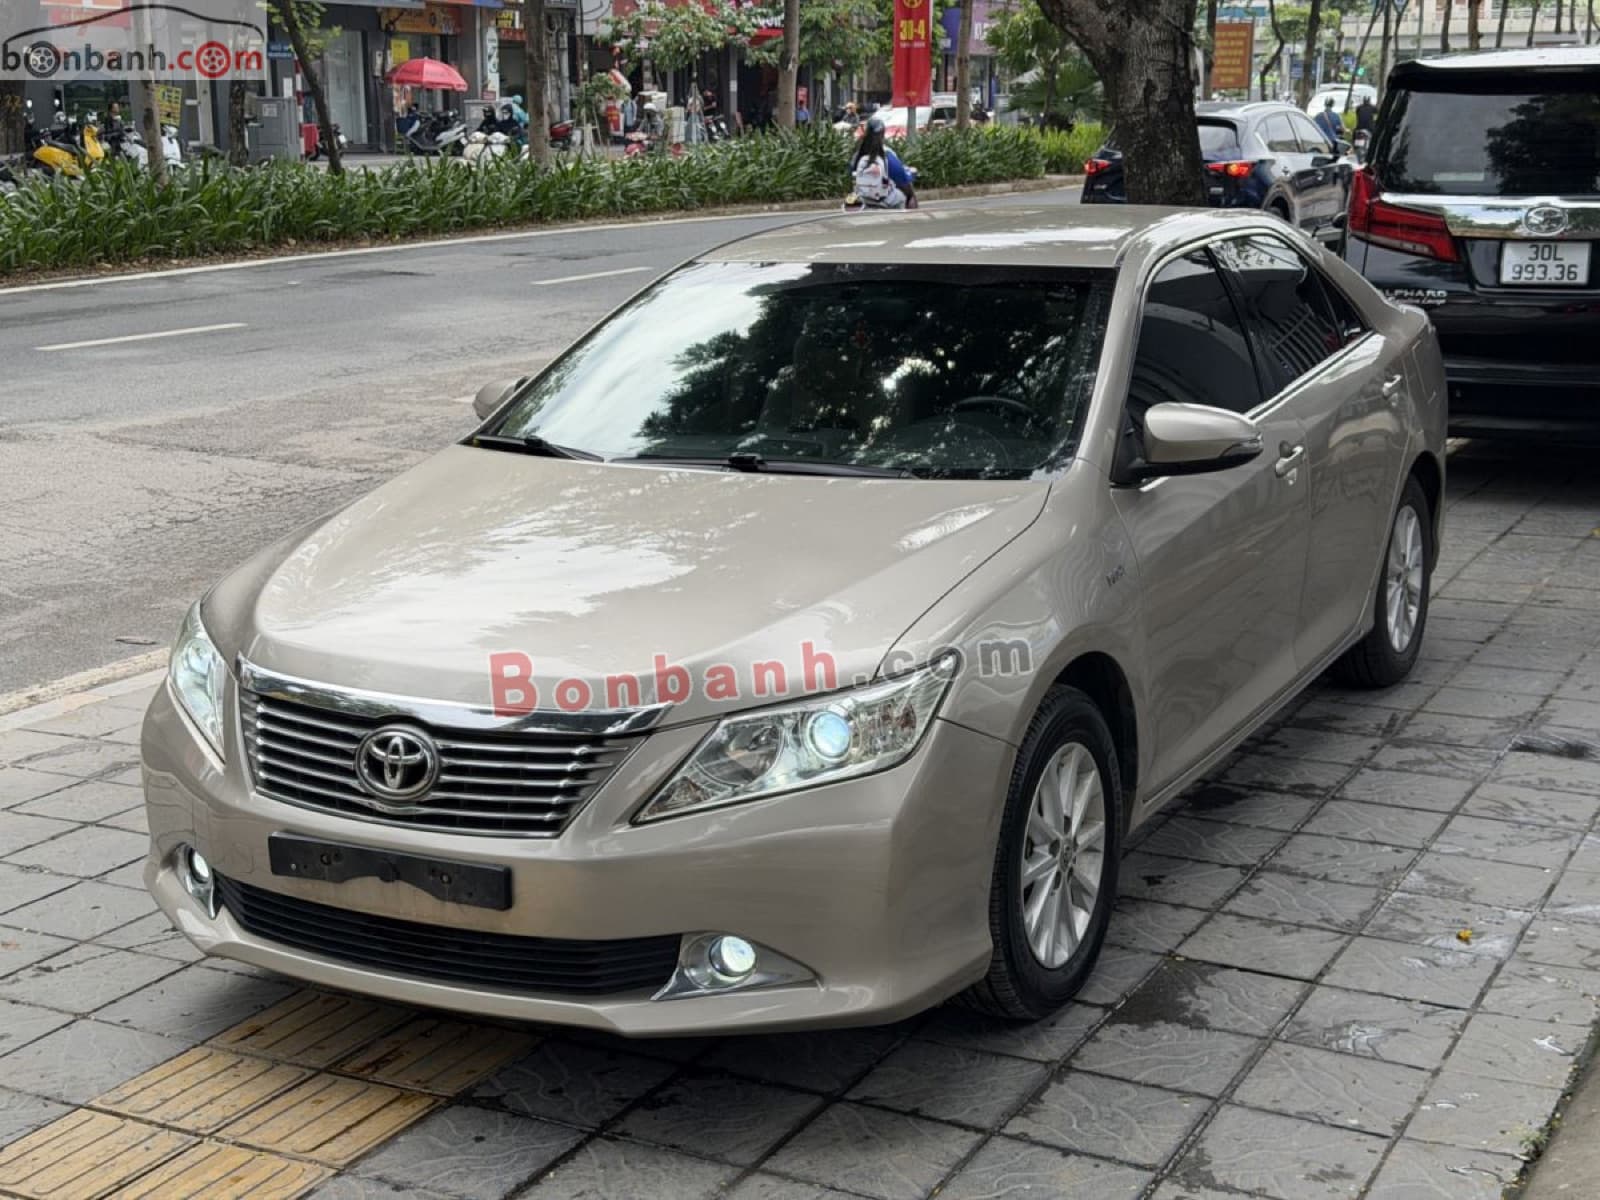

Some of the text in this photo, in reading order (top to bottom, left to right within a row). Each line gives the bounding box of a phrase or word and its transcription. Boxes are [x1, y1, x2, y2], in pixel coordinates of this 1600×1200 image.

[899, 19, 926, 41] 30-4
[1527, 244, 1564, 262] 30L
[1511, 263, 1579, 282] 993.36
